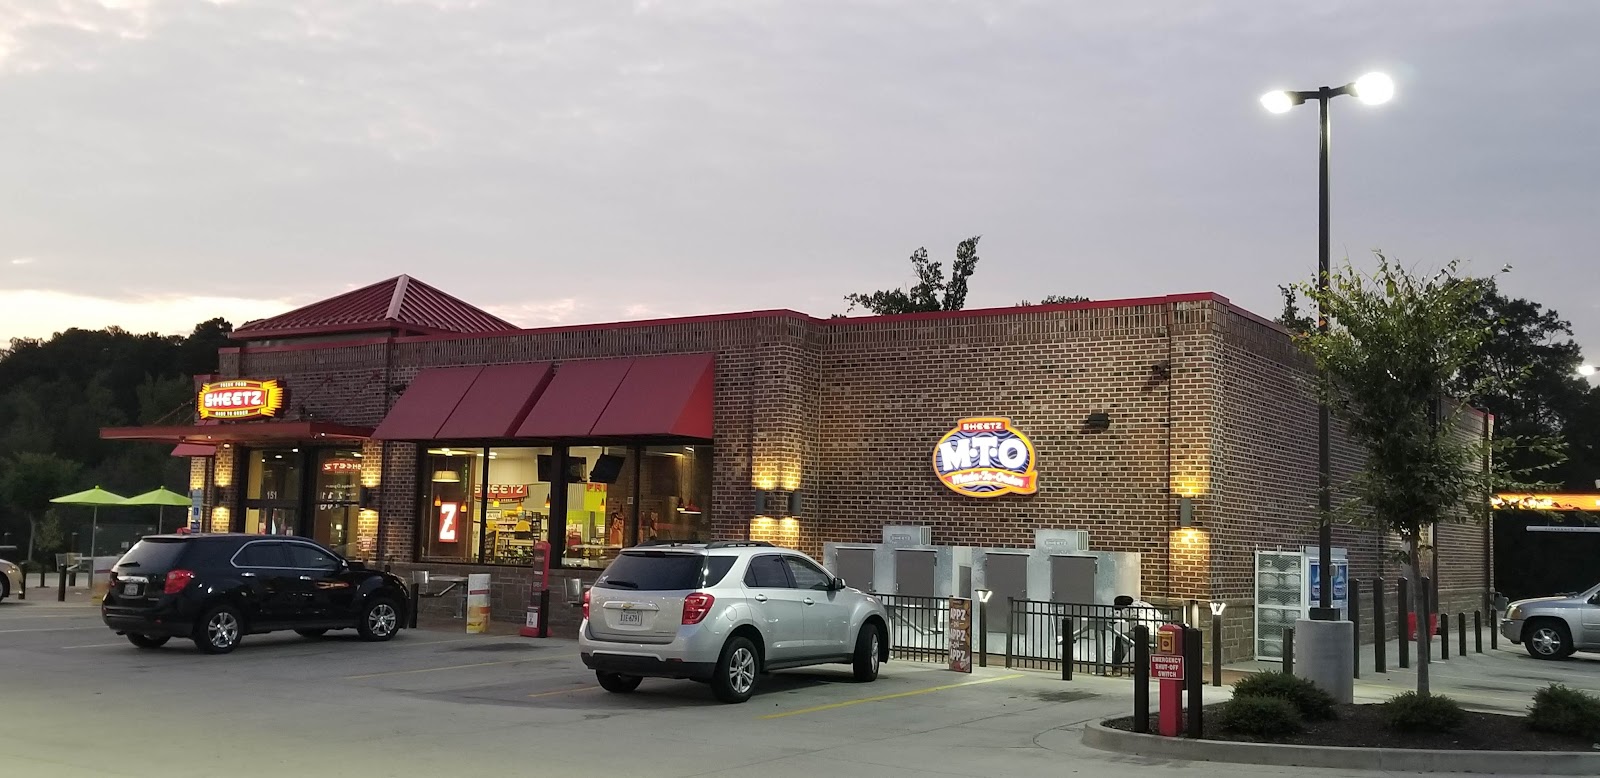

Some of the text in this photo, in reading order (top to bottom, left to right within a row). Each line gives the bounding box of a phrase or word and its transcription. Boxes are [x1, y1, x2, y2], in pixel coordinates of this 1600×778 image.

[204, 391, 262, 407] SHEETZ
[963, 422, 1003, 430] SHEETZ
[266, 491, 277, 500] 151
[474, 484, 524, 494] SEETZ
[440, 503, 457, 540] Z
[950, 608, 966, 621] APPZ
[950, 628, 966, 641] APPZ
[950, 649, 966, 662] APPZ
